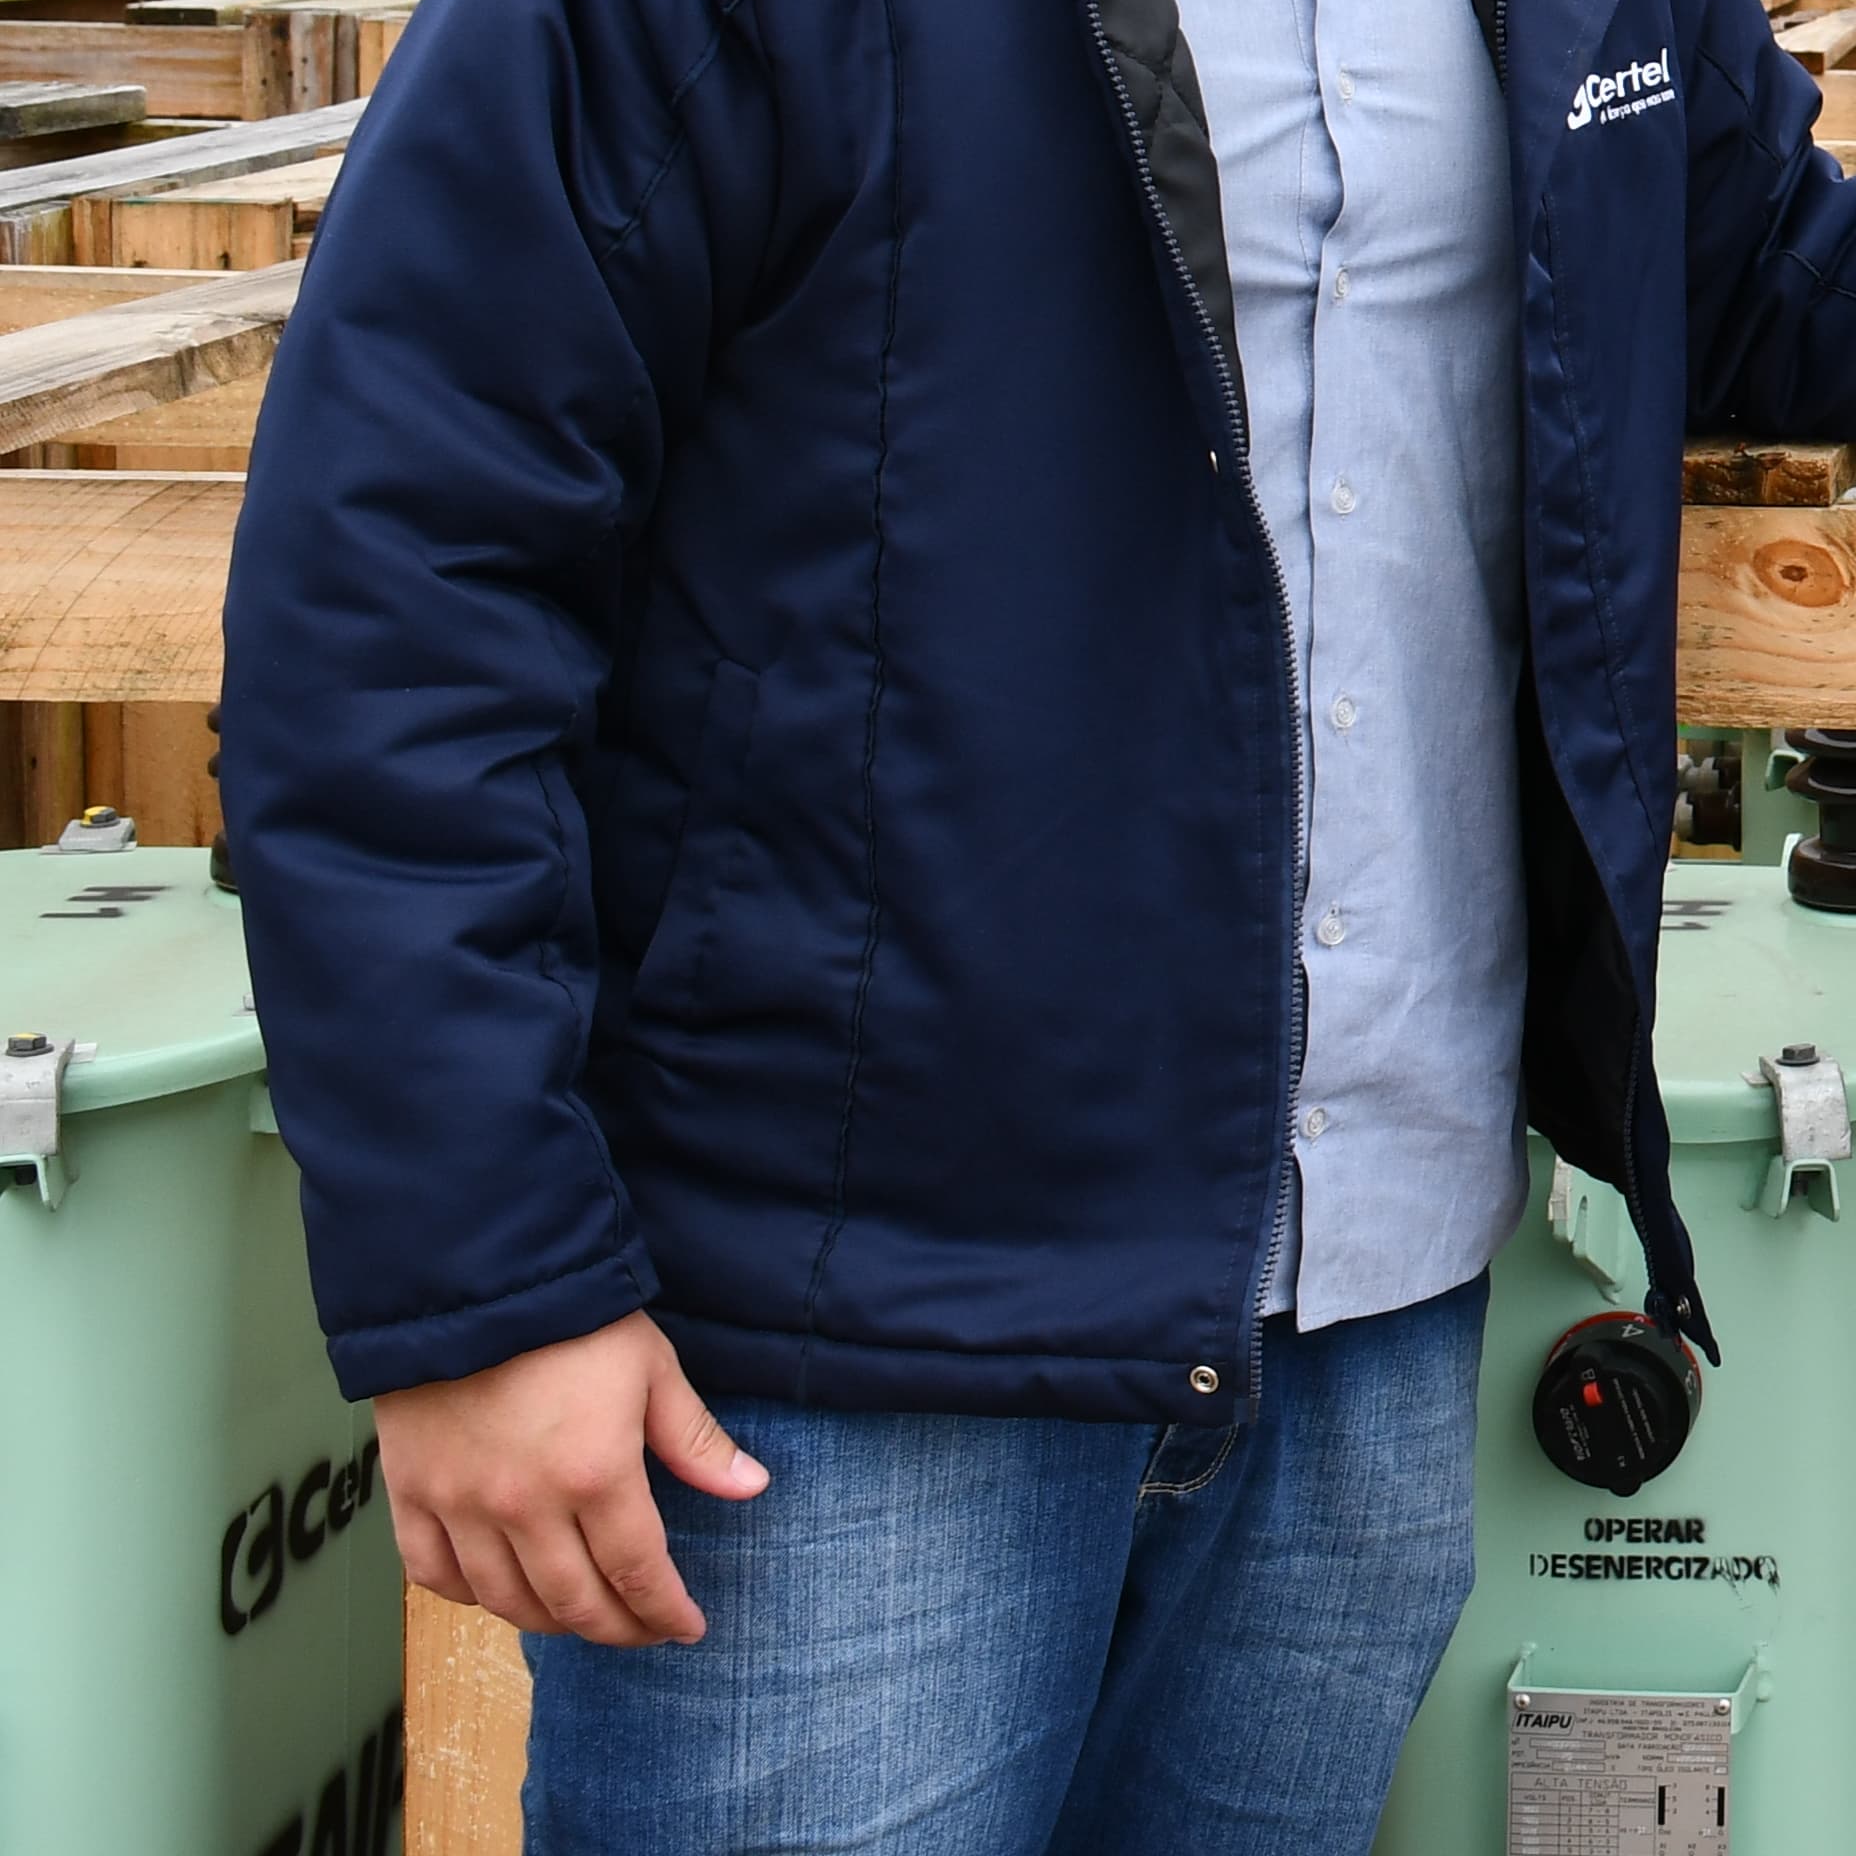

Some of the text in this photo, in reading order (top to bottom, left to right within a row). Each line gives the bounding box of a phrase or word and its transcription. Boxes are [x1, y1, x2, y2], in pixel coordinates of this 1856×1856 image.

[1586, 47, 1671, 108] Certel
[1584, 1517, 1706, 1544] OPERAR
[1530, 1553, 1780, 1584] DESENERGIZADO
[1515, 1713, 1573, 1729] ITAIPU
[1534, 1777, 1568, 1787] ALTA
